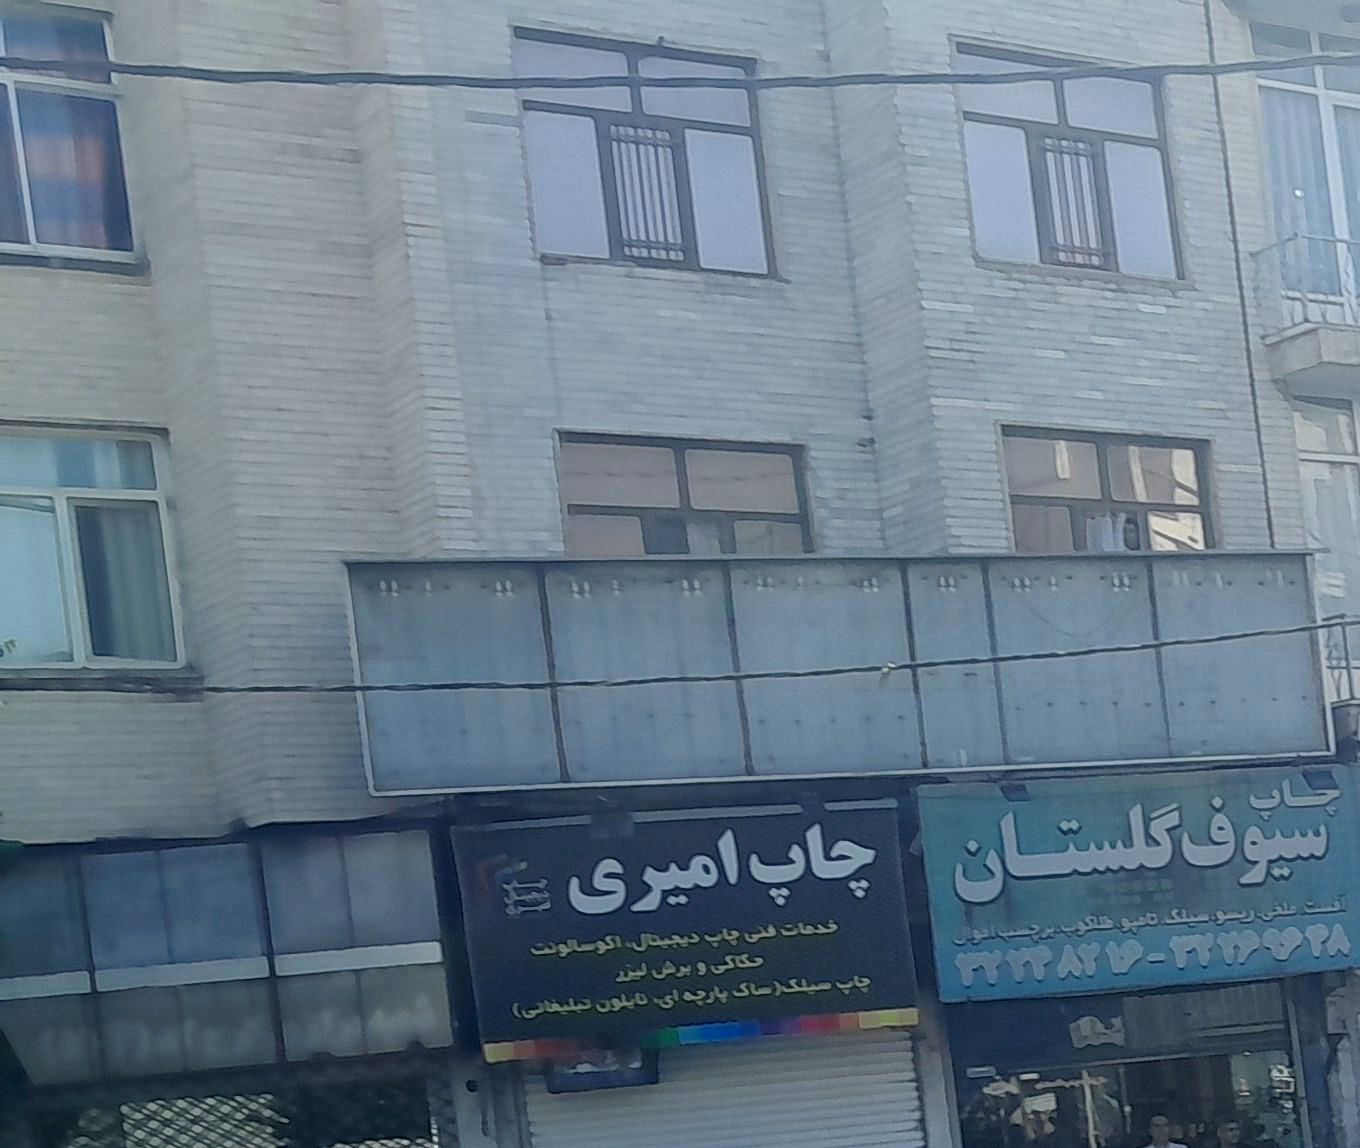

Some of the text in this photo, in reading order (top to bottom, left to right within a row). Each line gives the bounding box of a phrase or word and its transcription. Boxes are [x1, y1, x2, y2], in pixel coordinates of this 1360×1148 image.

[1248, 776, 1343, 819] چاپ
[953, 801, 1182, 904] گلستان
[568, 828, 741, 915] امیری
[749, 823, 877, 906] چاپ
[703, 927, 740, 947] چاپ
[743, 924, 777, 943] فنی
[780, 919, 839, 937] خدمات
[615, 953, 764, 983] حکاکی و برش لیزر
[682, 985, 729, 1005] پارچه
[834, 974, 872, 994] چاپ
[595, 991, 648, 1014] نایلون
